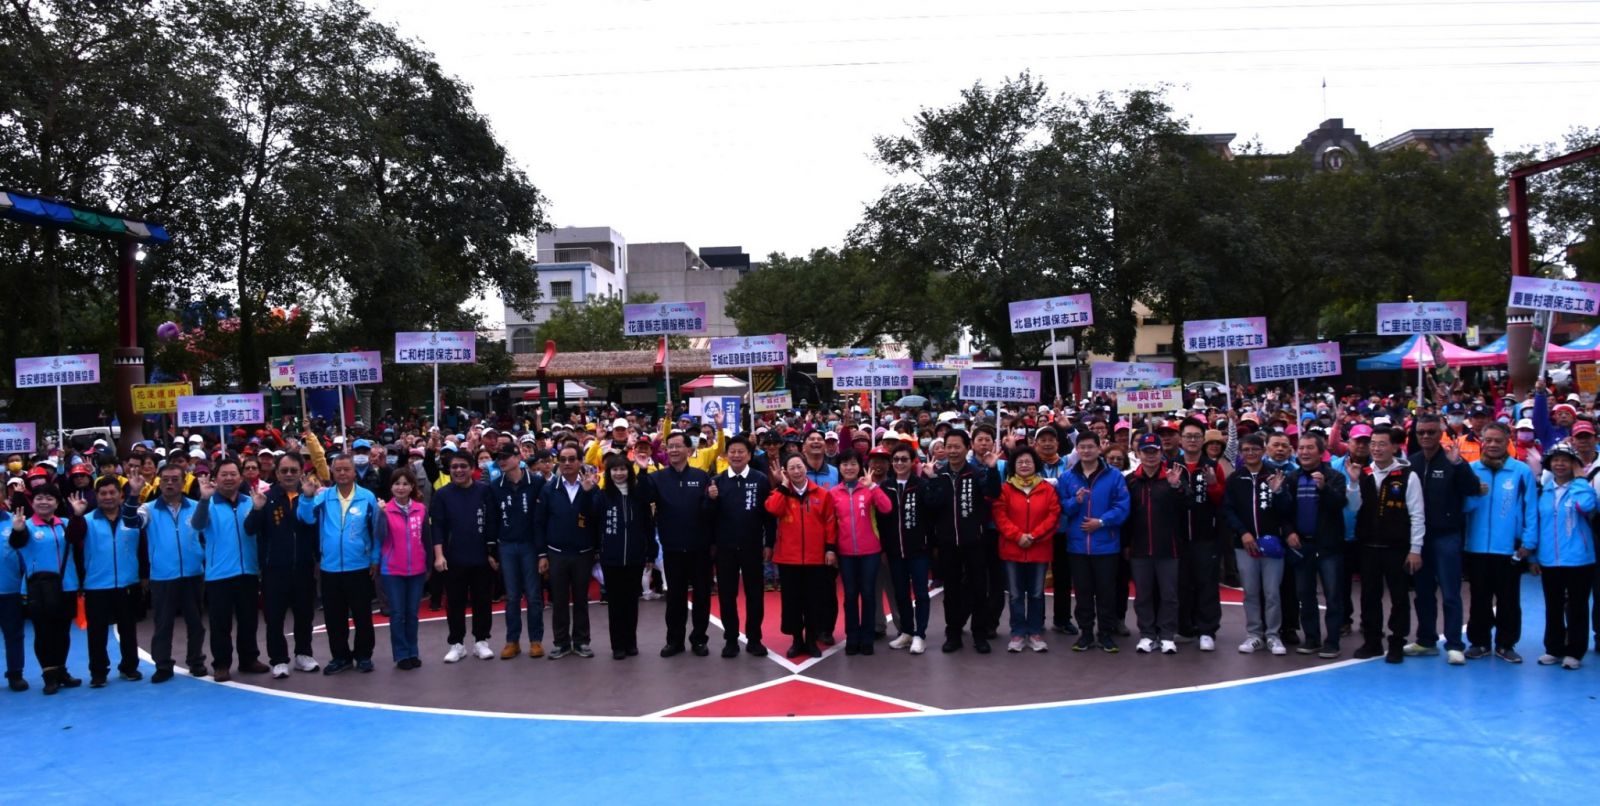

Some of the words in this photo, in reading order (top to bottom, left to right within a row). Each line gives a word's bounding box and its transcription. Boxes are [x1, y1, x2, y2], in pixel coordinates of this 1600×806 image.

[628, 317, 702, 333] 花蓮縣志願服務協會
[1014, 311, 1088, 329] 北昌村環保志工隊
[1381, 317, 1462, 333] 仁里社區發展協會
[1189, 334, 1263, 349] 東昌村環保志工隊
[399, 347, 471, 360] 仁和村環保志工隊
[299, 367, 377, 385] 稻香社區發展協會
[836, 375, 909, 387] 吉安社區發展協會
[1127, 390, 1173, 402] 福興社區
[182, 409, 260, 424] 南華老人會環保志工隊
